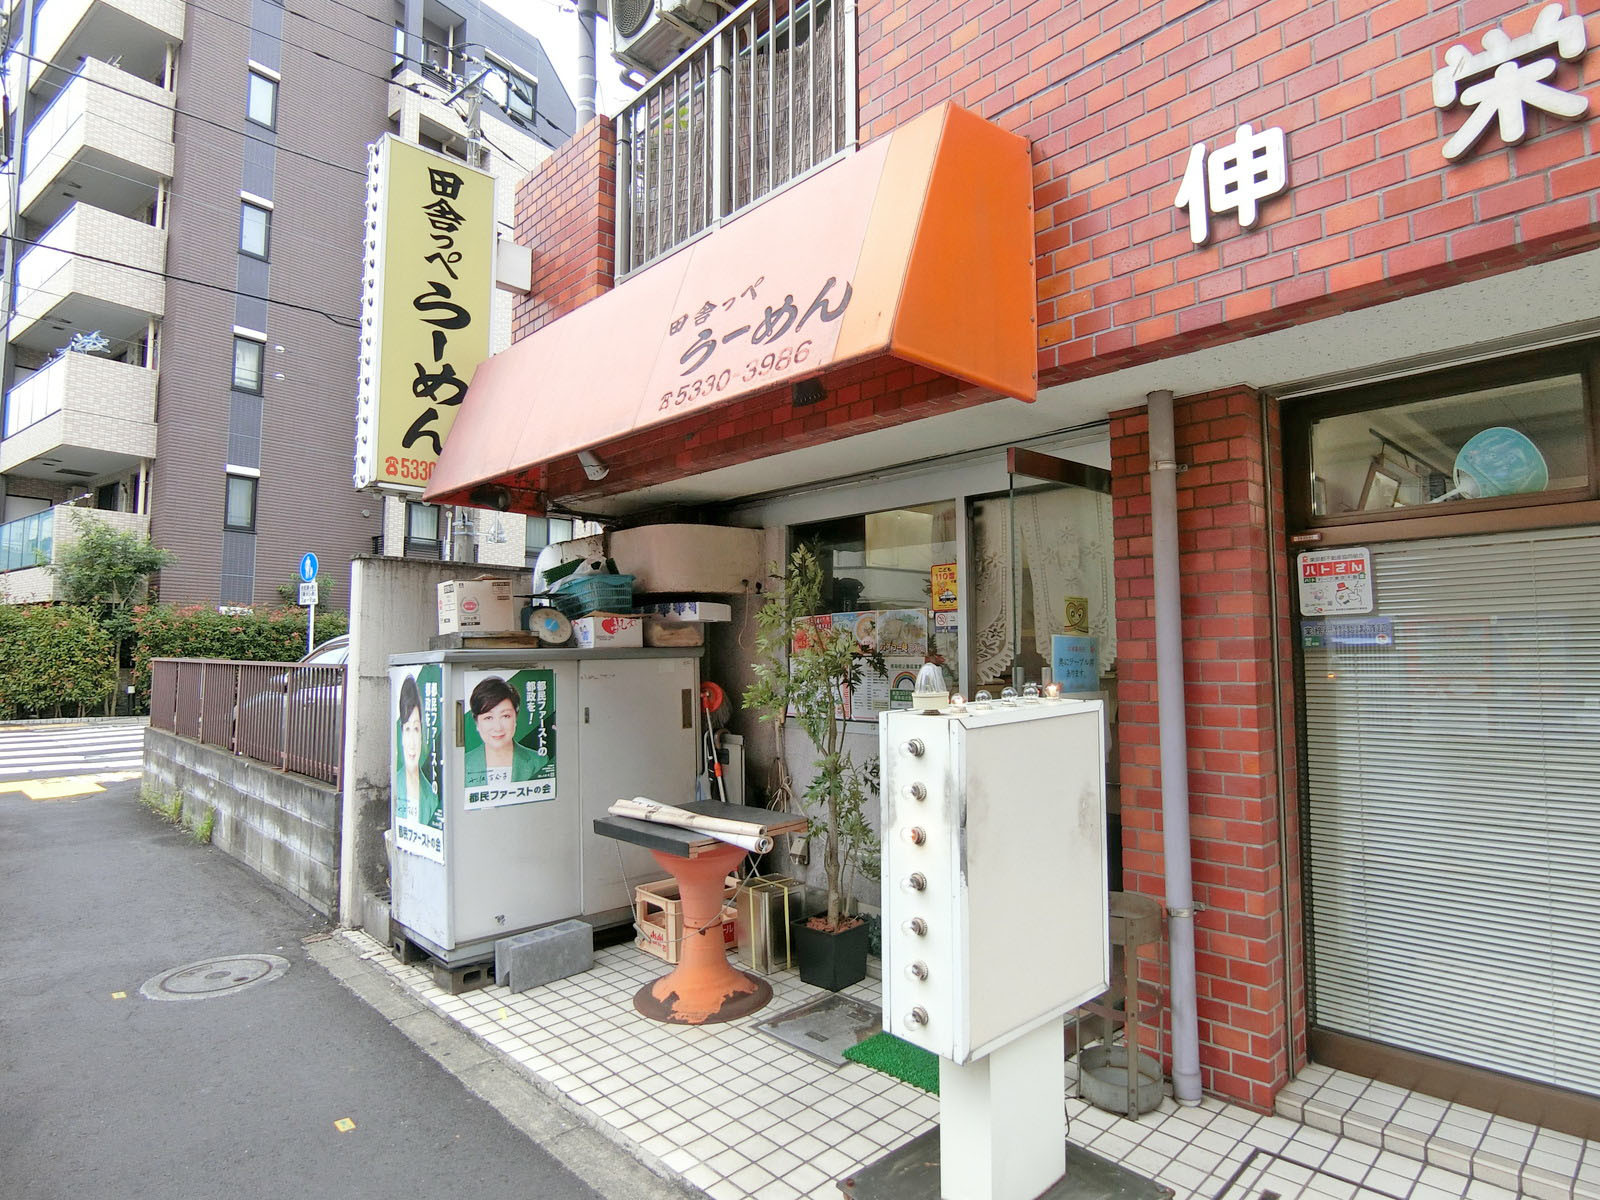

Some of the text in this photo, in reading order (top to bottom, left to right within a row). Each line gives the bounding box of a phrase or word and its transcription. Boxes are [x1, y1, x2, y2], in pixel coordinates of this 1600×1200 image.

[669, 276, 765, 336] 田舎っぺ
[679, 276, 853, 377] らーめん
[1304, 561, 1363, 576] ハトさん
[537, 680, 548, 756] 都民ファーストの
[469, 784, 551, 803] 都民ファーストの会
[398, 824, 441, 852] 都民ファーストの会
